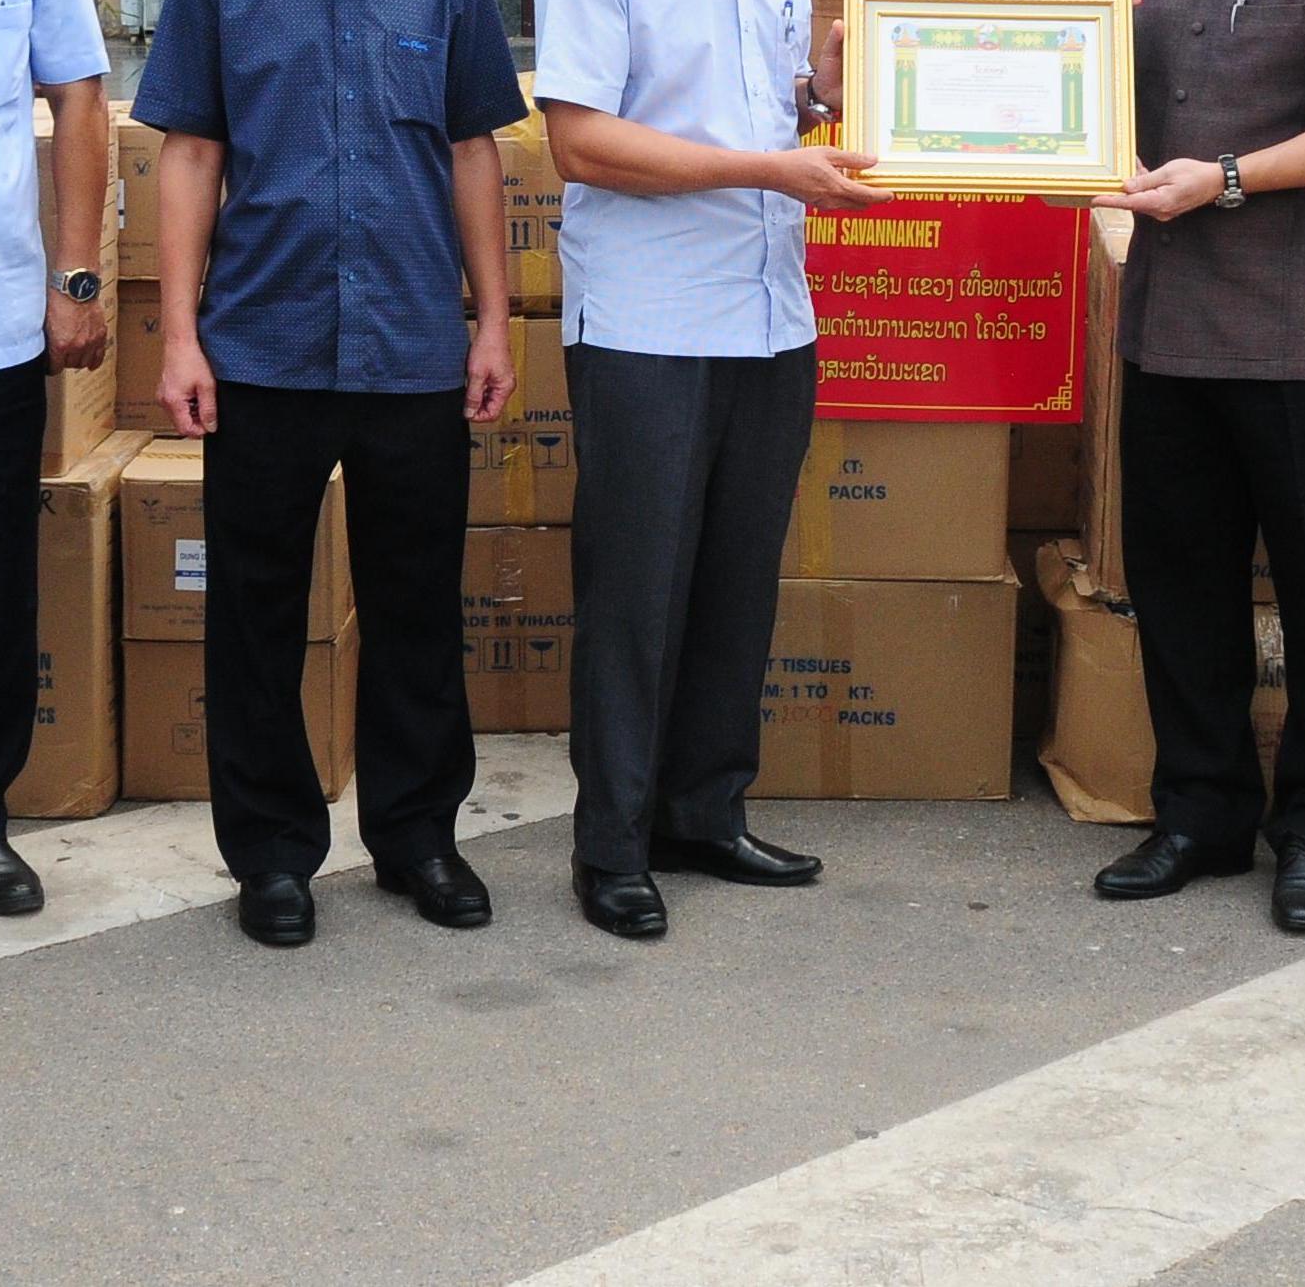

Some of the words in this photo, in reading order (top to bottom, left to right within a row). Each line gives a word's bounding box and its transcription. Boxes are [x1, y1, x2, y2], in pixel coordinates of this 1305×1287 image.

[535, 195, 562, 206] VIH
[841, 217, 942, 248] SAVANNAKHET
[524, 410, 573, 423] VIHAC
[828, 485, 887, 500] PACKS
[781, 659, 852, 673] TISSUES
[849, 686, 874, 700] KT:
[839, 711, 895, 725] PACKS
